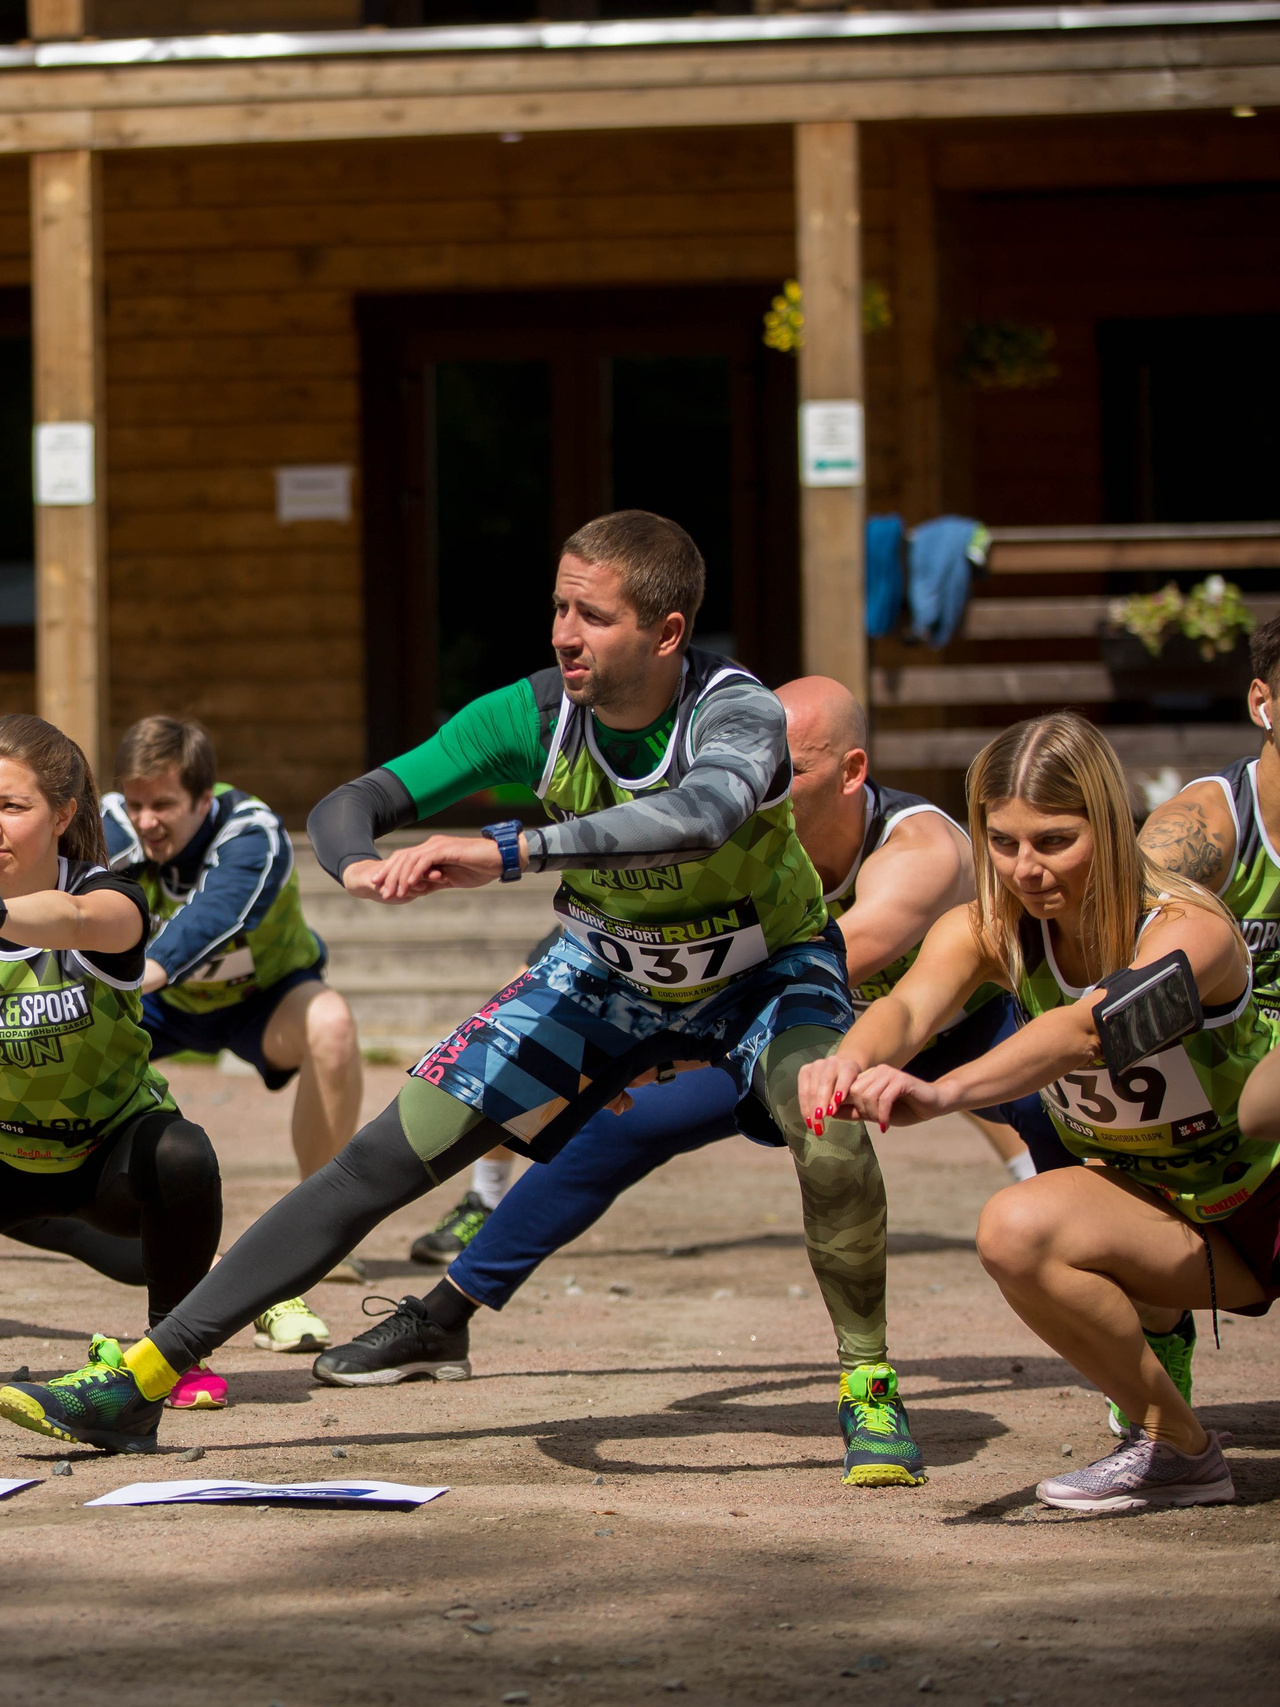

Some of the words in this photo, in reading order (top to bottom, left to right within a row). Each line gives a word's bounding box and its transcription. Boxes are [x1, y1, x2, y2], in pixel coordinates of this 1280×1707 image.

[593, 865, 682, 890] RUN
[567, 902, 662, 943] WORK&SPORT
[661, 909, 741, 944] RUN
[586, 931, 735, 985] 037
[657, 989, 699, 999] СОСНОВКА
[62, 1017, 89, 1031] ЗАБЕГ
[1100, 1132, 1142, 1143] СОСНОВКА
[1142, 1131, 1165, 1142] ПАРК
